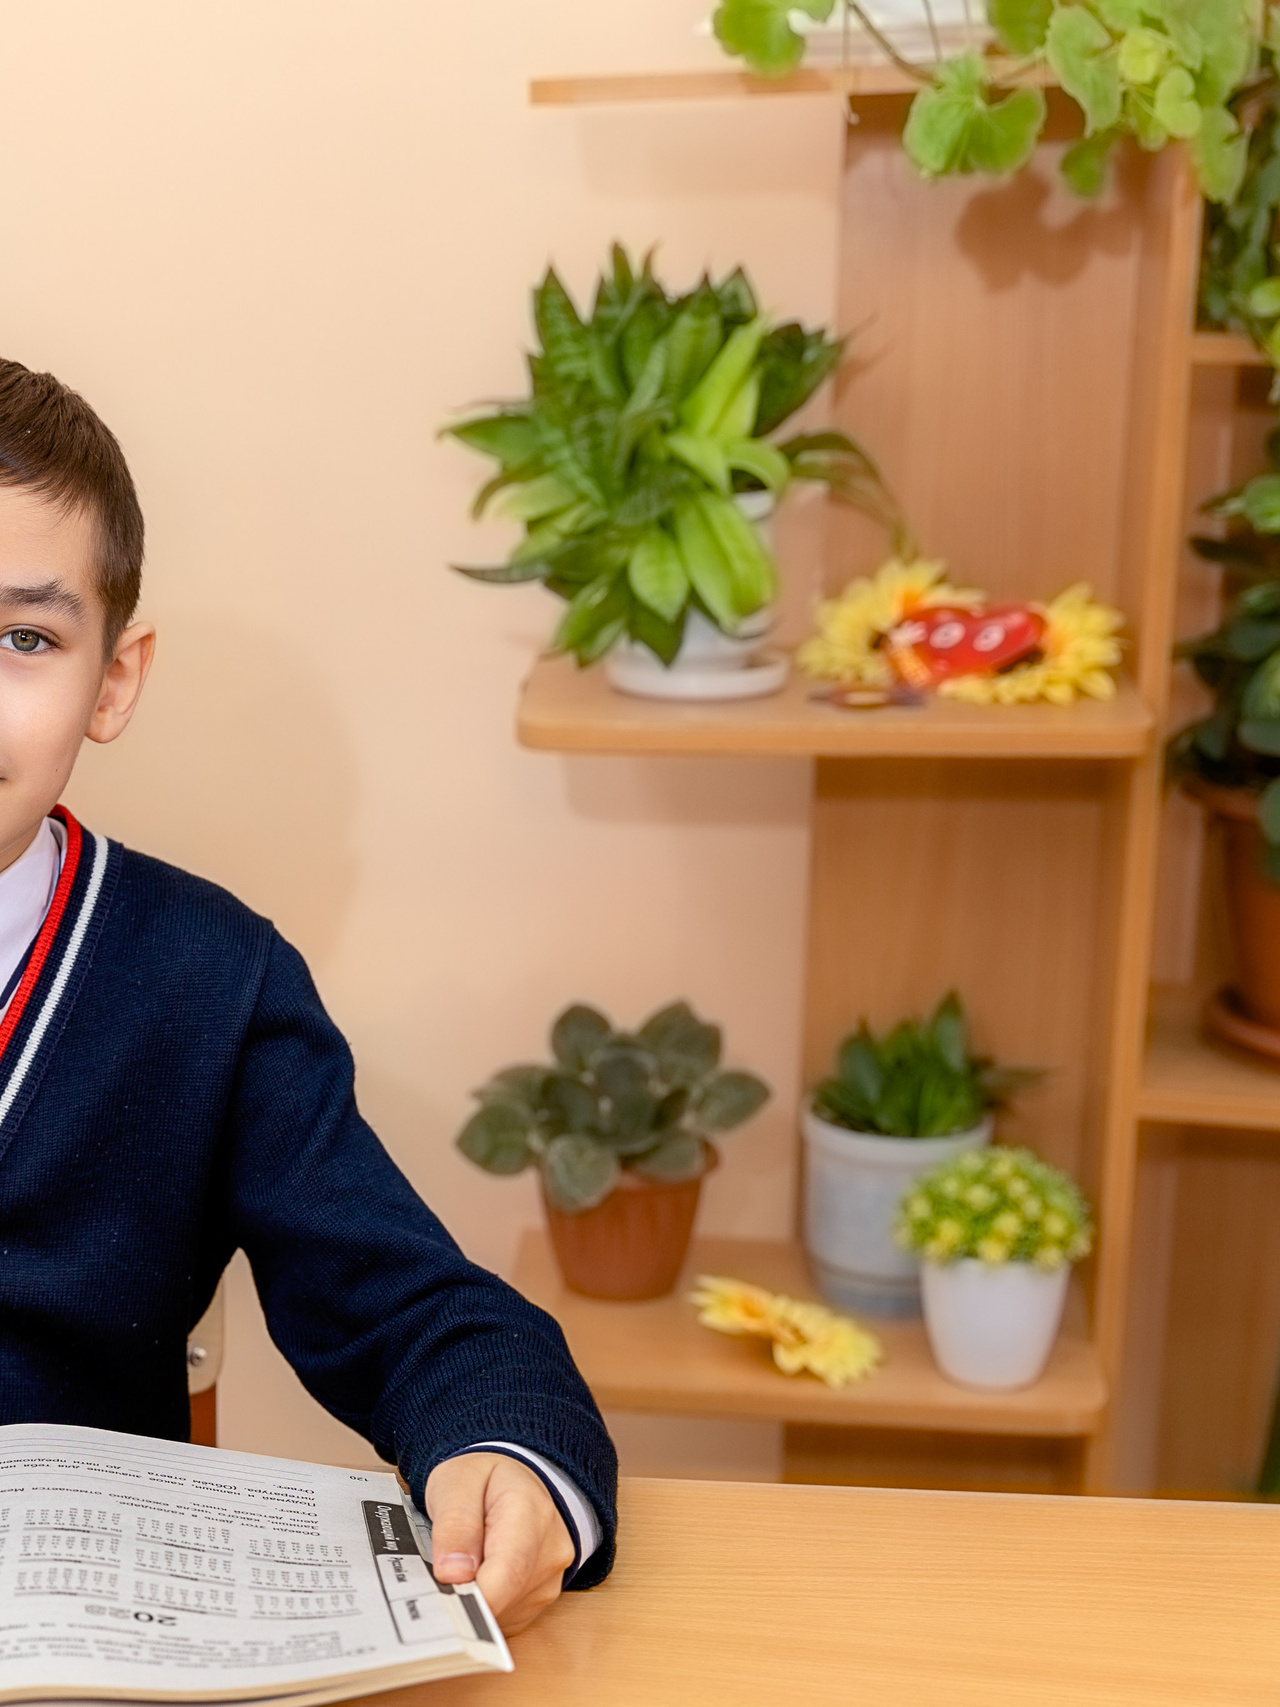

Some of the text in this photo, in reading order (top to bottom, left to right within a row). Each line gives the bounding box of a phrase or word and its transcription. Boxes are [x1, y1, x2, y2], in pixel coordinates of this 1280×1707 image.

[87, 1467, 141, 1478] значение
[147, 1471, 187, 1481] ответа
[149, 1477, 184, 1486] какое
[192, 1480, 237, 1490] (Объём
[32, 1487, 102, 1495] отмечается
[191, 1485, 241, 1496] напиши,
[243, 1488, 315, 1501] литература.
[273, 1485, 315, 1494] Ответ.
[108, 1493, 170, 1507] ежегодно
[261, 1496, 316, 1507] Подумай
[116, 1500, 185, 1516] календаре.
[176, 1505, 211, 1514] числа
[189, 1502, 227, 1511] книги.
[233, 1510, 283, 1520] детской
[274, 1508, 318, 1517] Ответ.
[218, 1513, 260, 1523] какого
[267, 1520, 319, 1529] Запиши,
[273, 1527, 320, 1537] Обведи
